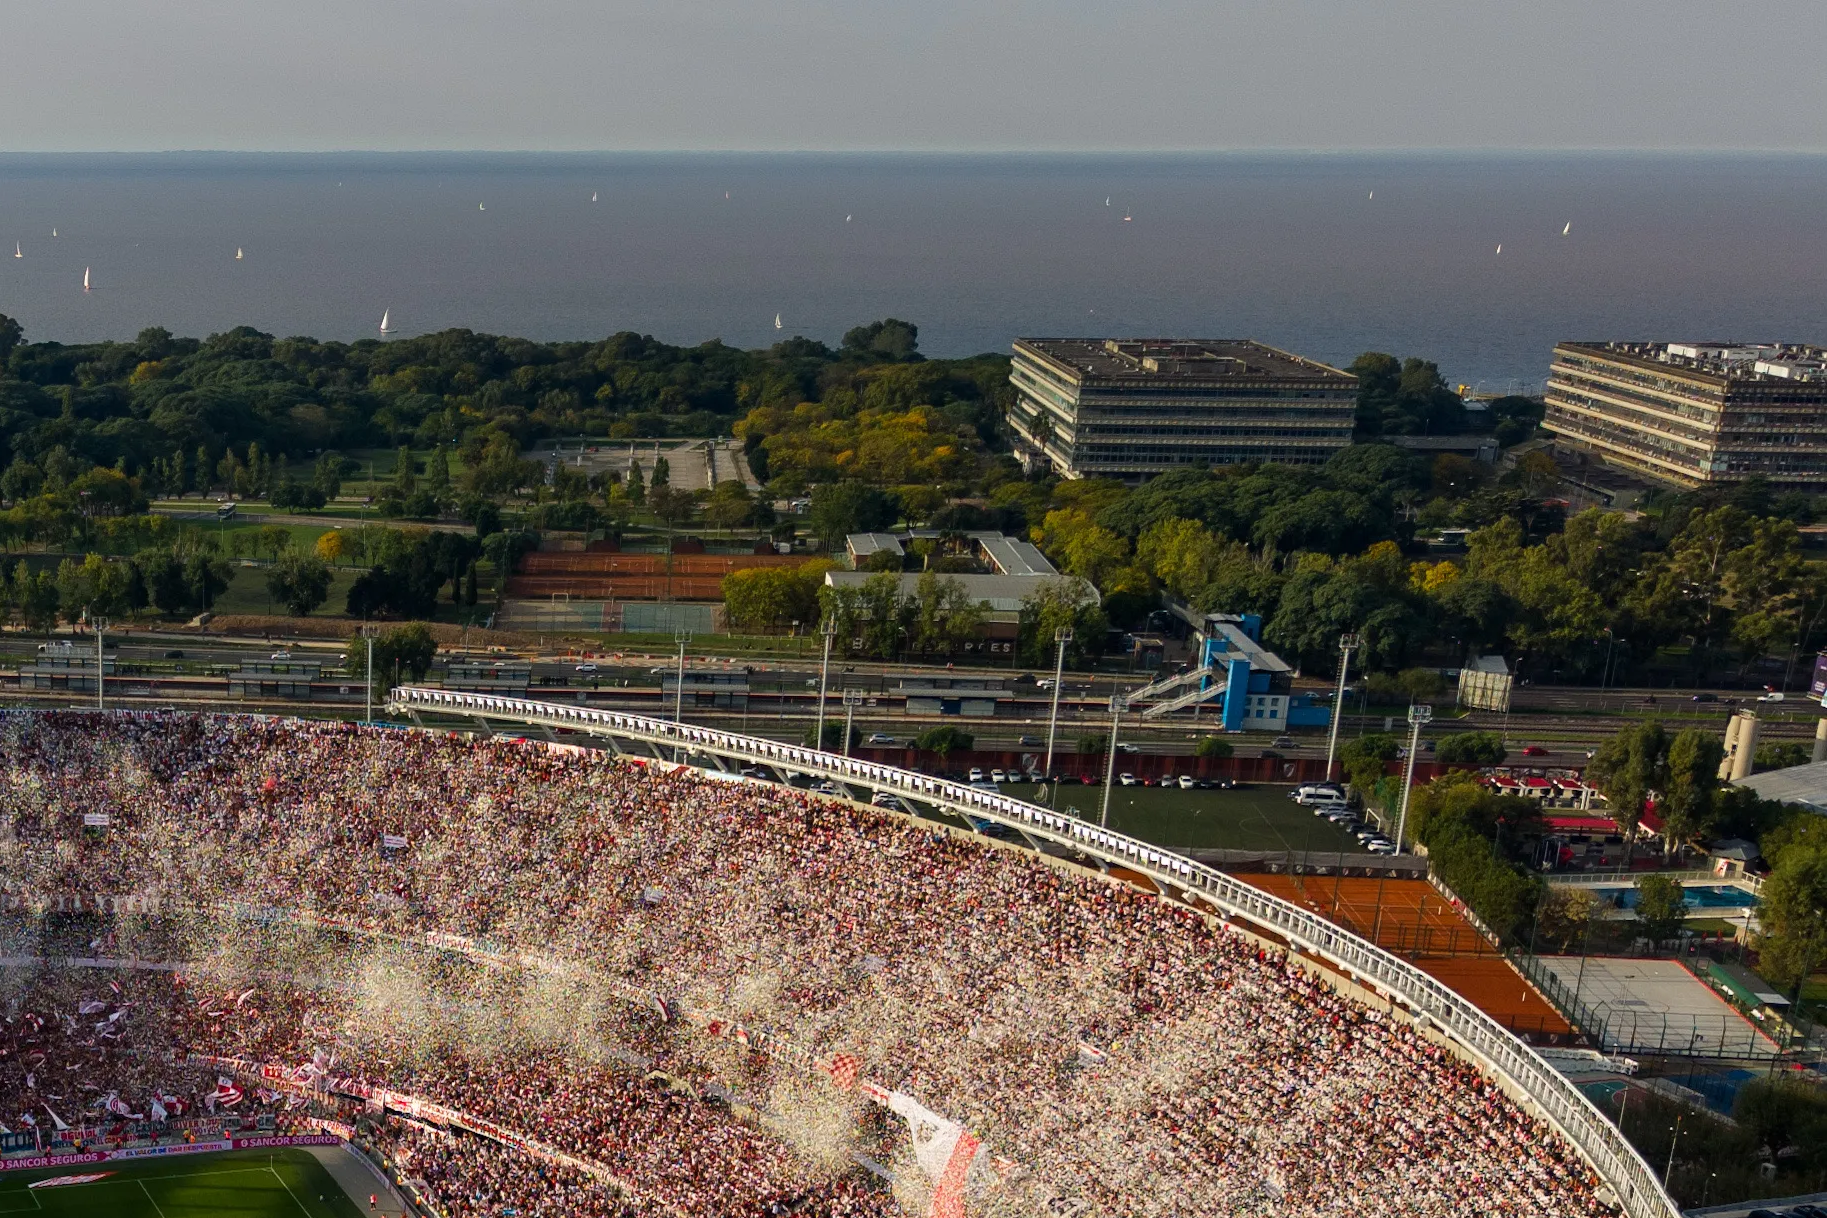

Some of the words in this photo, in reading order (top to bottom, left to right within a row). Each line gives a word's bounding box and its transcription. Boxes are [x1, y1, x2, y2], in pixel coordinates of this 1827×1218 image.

[249, 1136, 291, 1147] SANCOR
[292, 1135, 339, 1146] SEGUROS
[6, 1156, 49, 1169] SANCOR
[50, 1152, 98, 1166] SEGUROS
